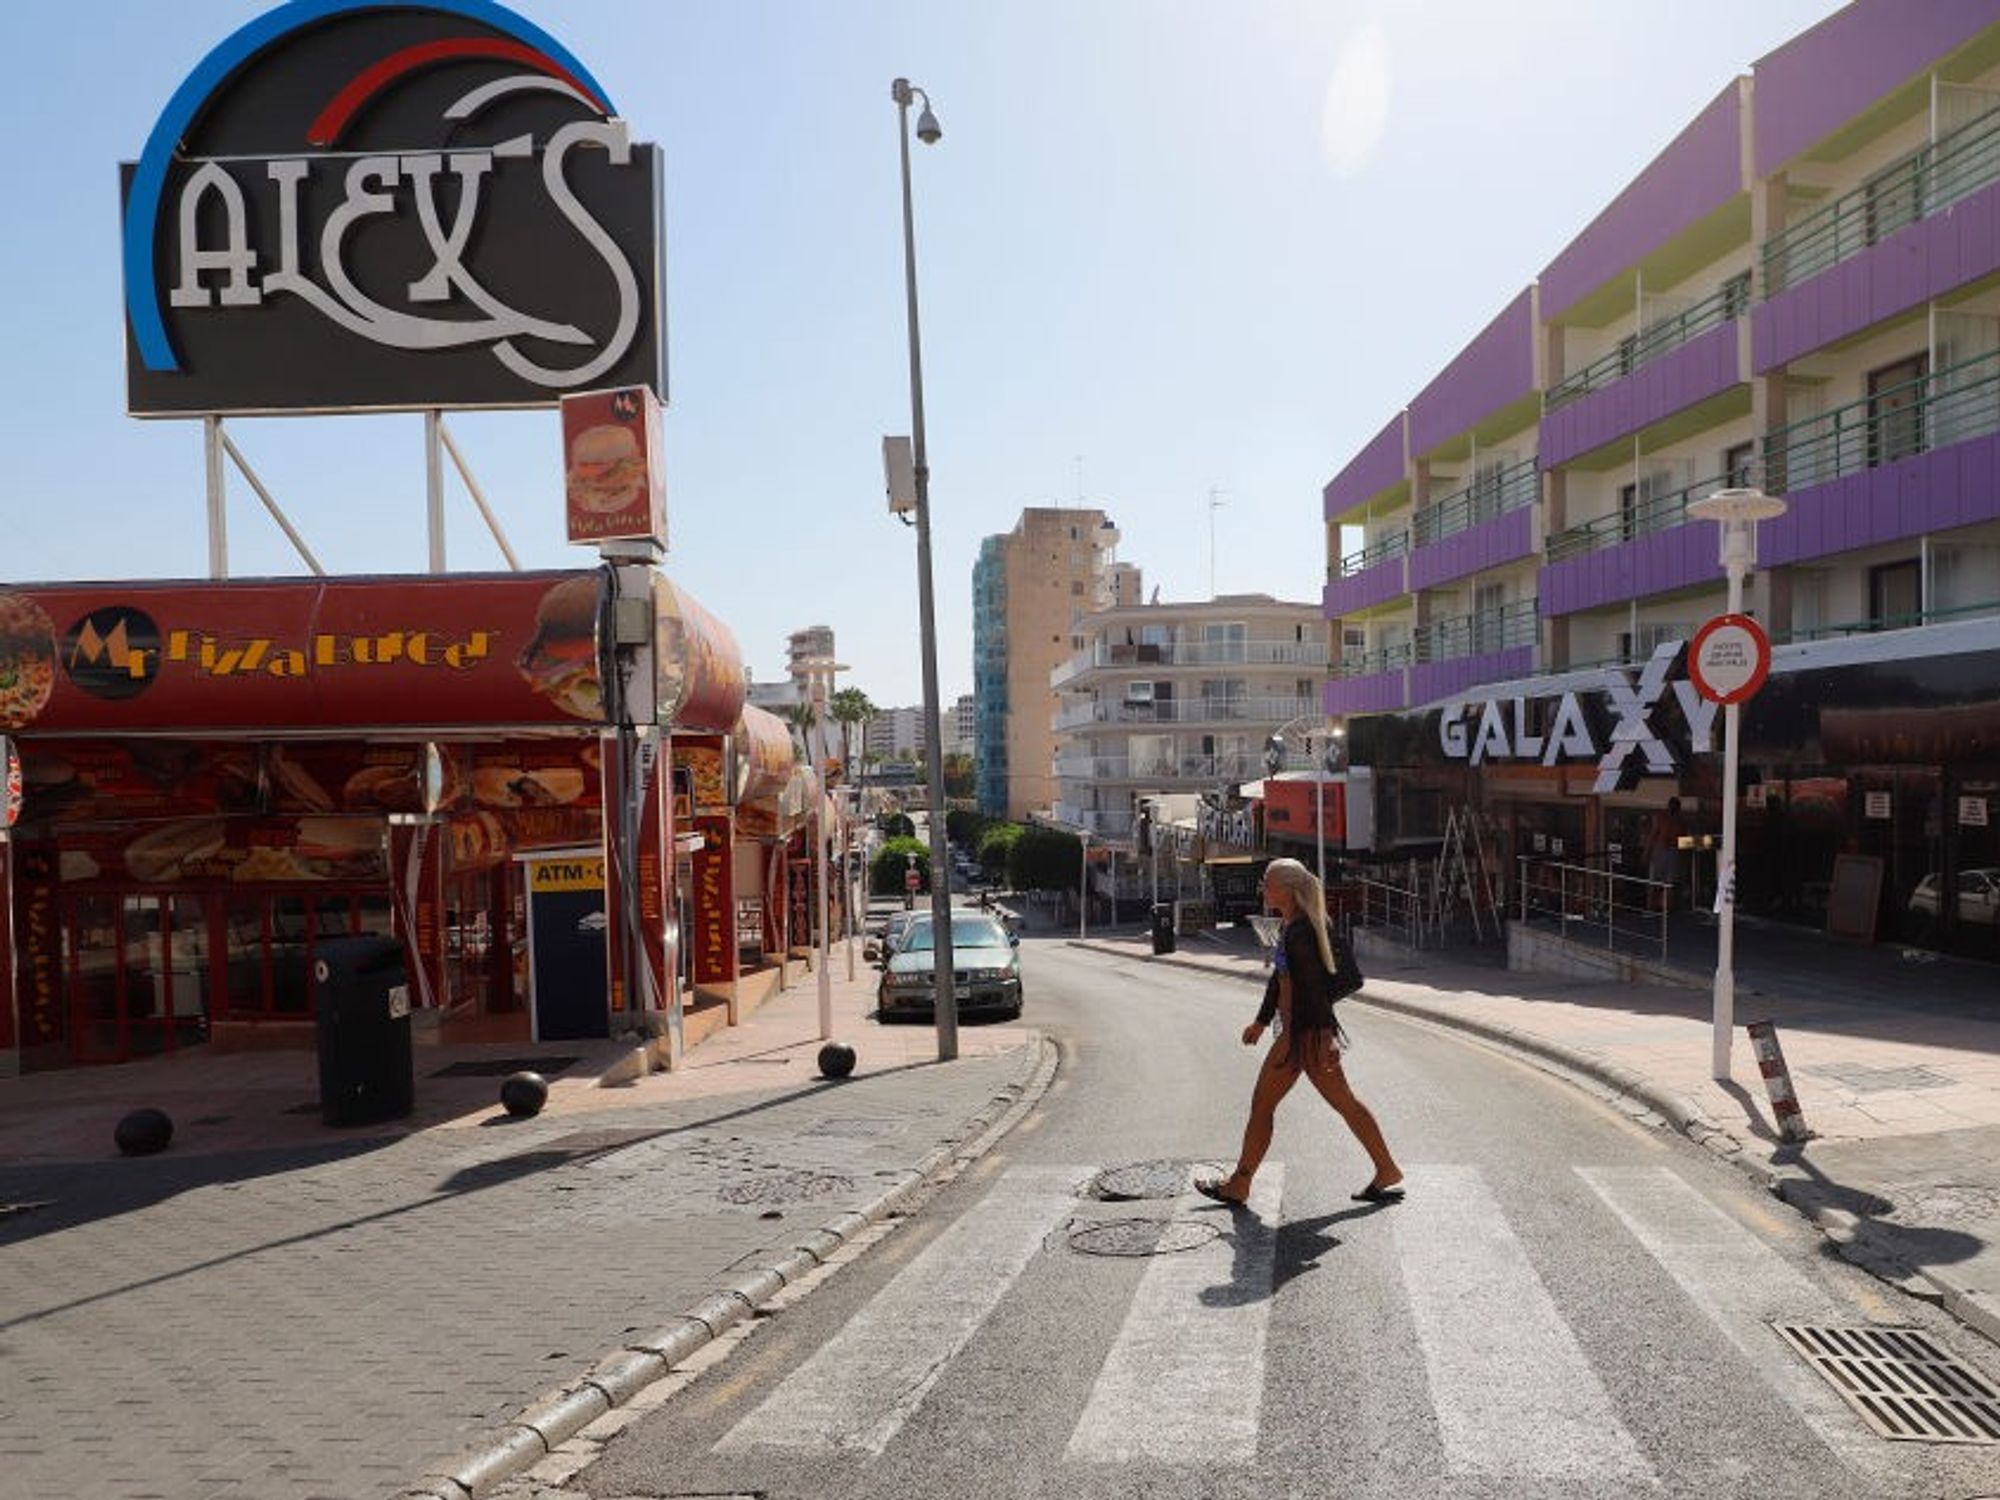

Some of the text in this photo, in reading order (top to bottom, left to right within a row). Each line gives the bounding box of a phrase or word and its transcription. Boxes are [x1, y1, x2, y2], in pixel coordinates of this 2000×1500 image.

[169, 116, 640, 388] ALEX'S
[70, 617, 157, 679] Mr
[1439, 639, 1720, 793] GALAXY
[536, 864, 584, 883] ATM
